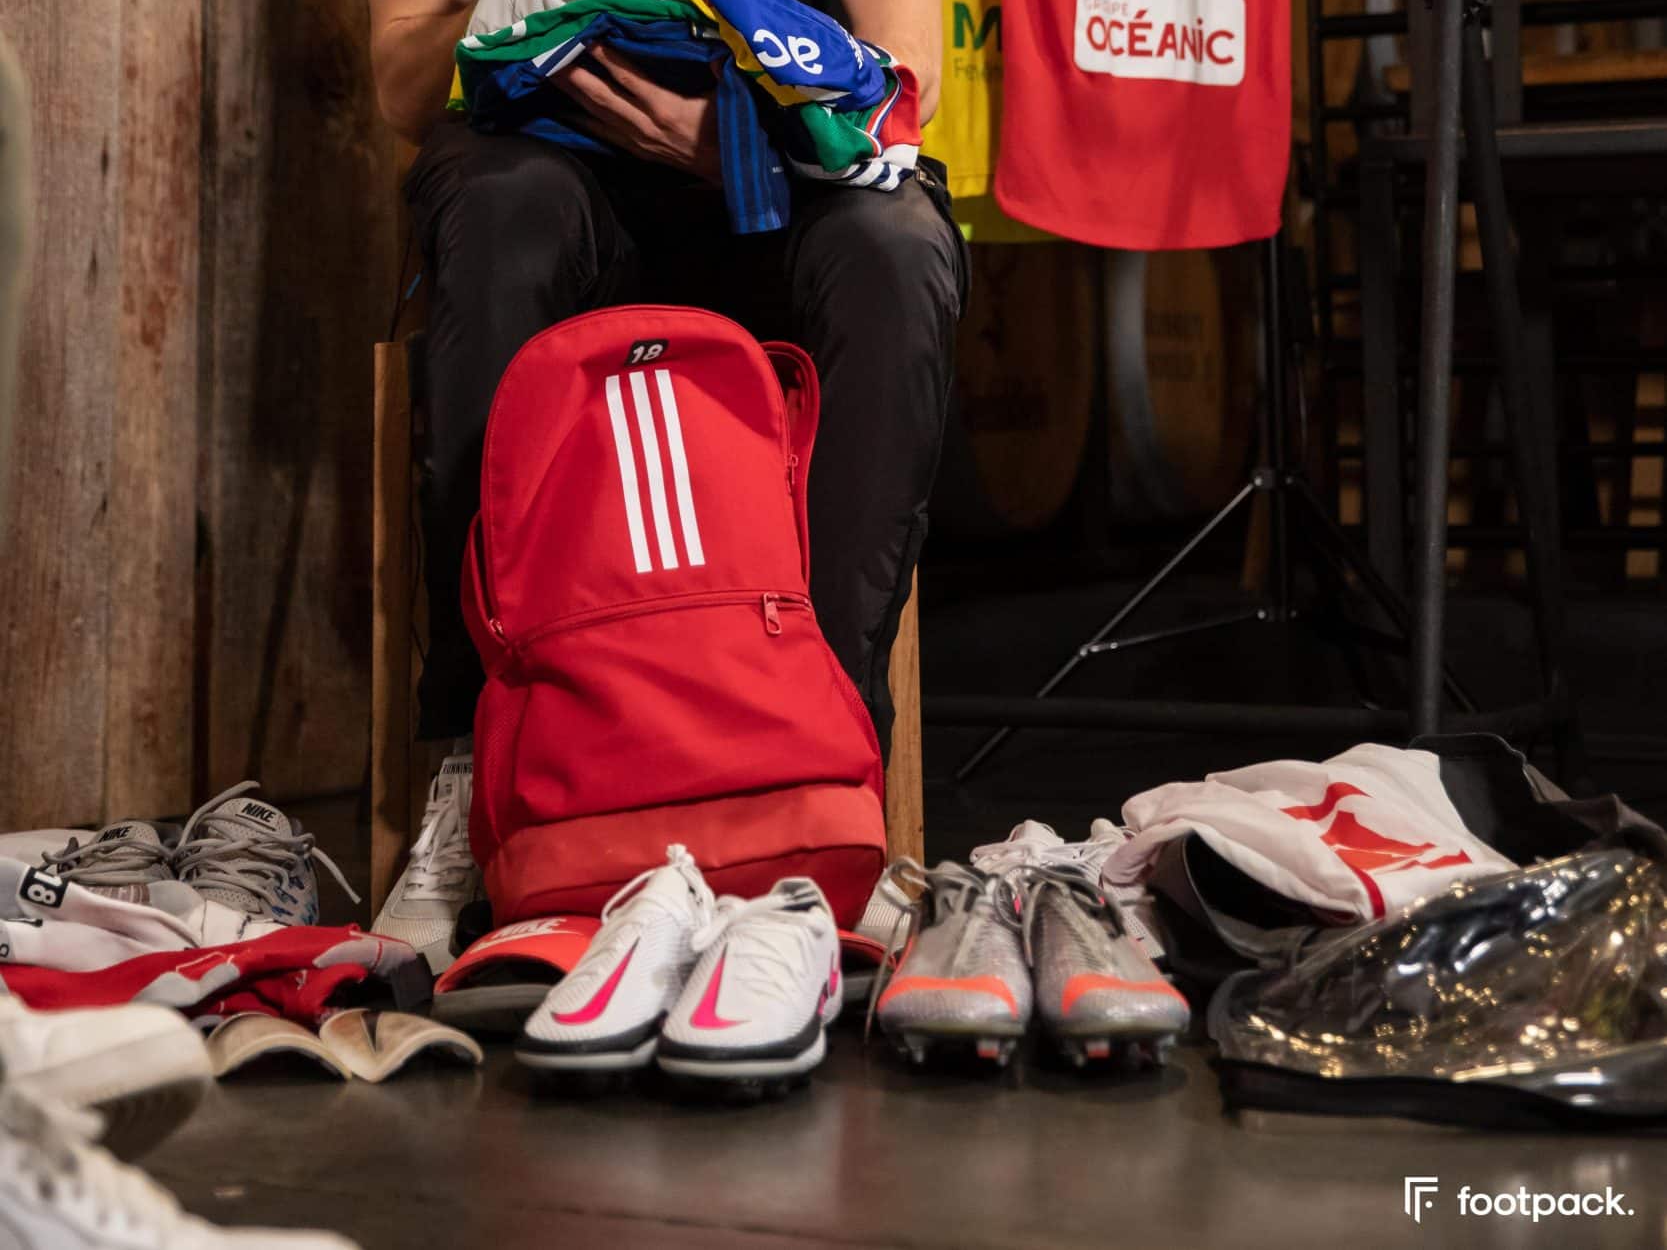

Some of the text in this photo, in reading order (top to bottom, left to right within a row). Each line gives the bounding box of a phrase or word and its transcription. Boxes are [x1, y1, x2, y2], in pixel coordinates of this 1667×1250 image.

[631, 343, 664, 364] 18
[241, 802, 277, 823] NIKE
[98, 826, 133, 843] NIKE
